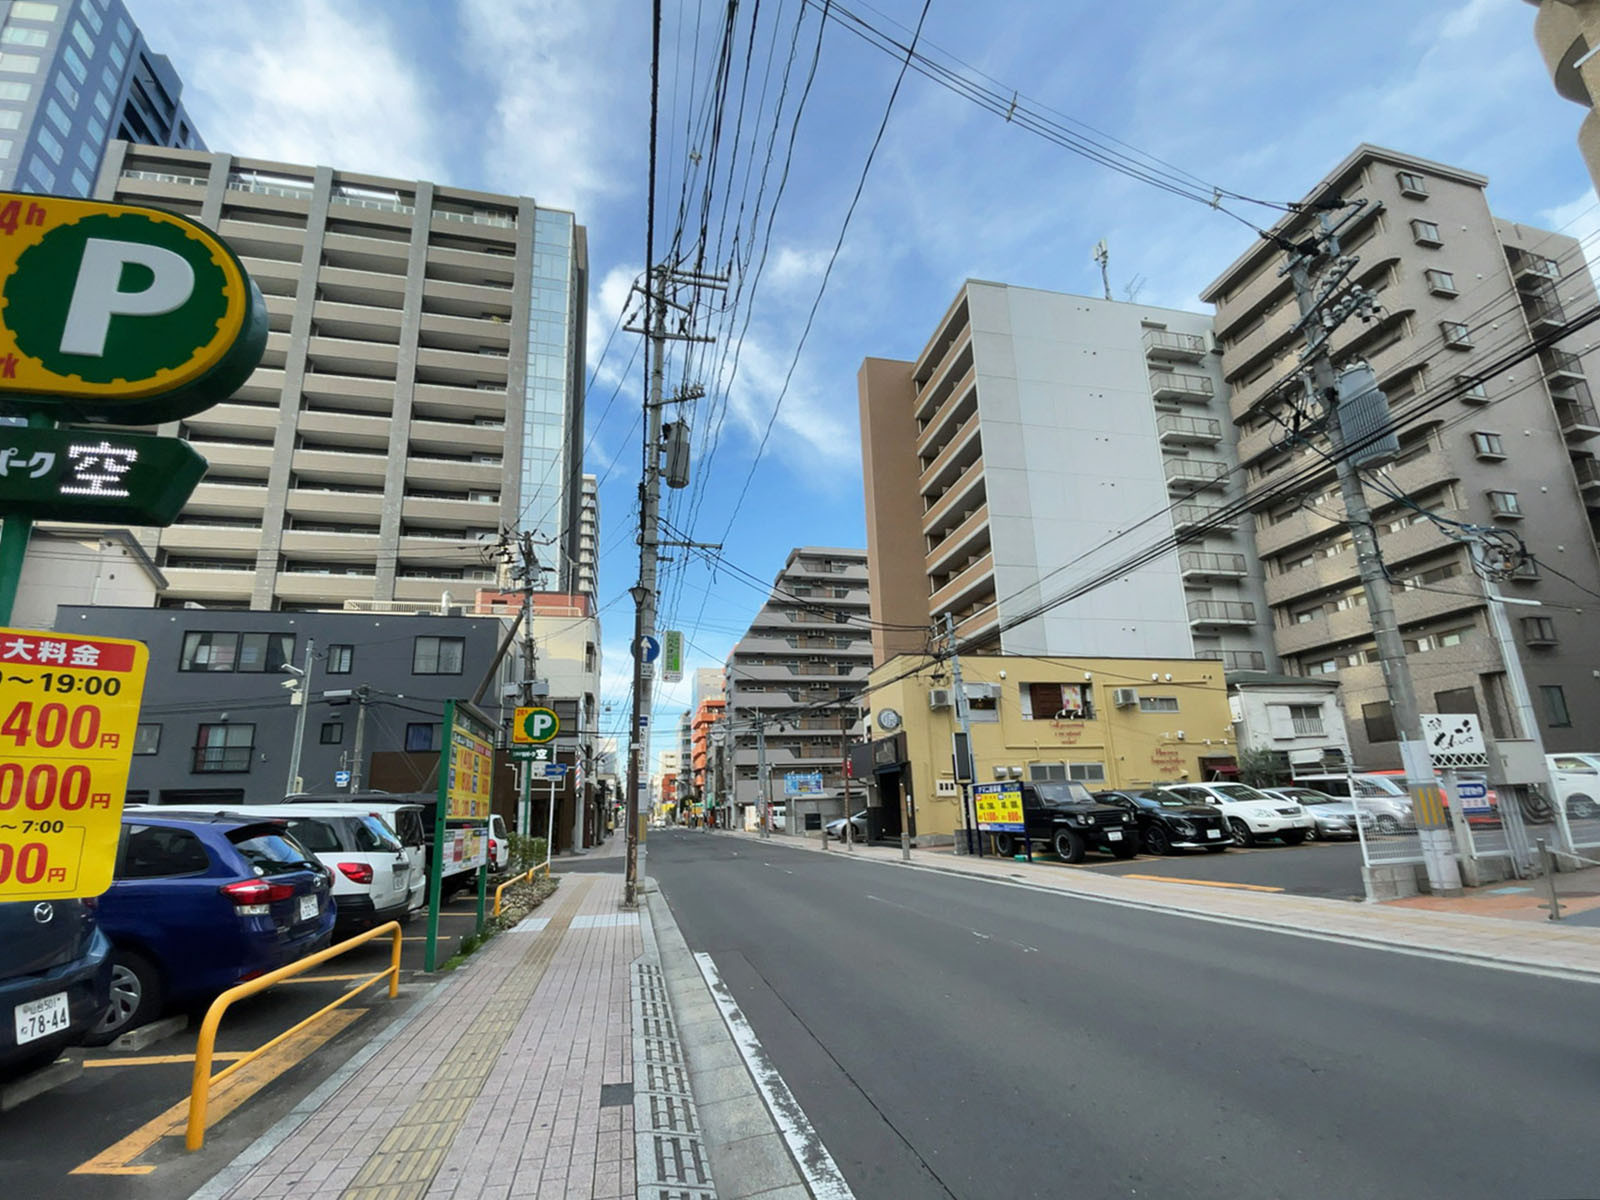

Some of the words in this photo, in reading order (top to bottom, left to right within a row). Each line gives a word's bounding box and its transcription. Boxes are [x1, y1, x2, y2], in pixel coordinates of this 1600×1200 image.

[59, 237, 195, 358] P
[59, 441, 139, 498] 空
[0, 637, 102, 667] 大料金
[532, 714, 553, 737] P
[28, 1007, 67, 1038] 78-44
